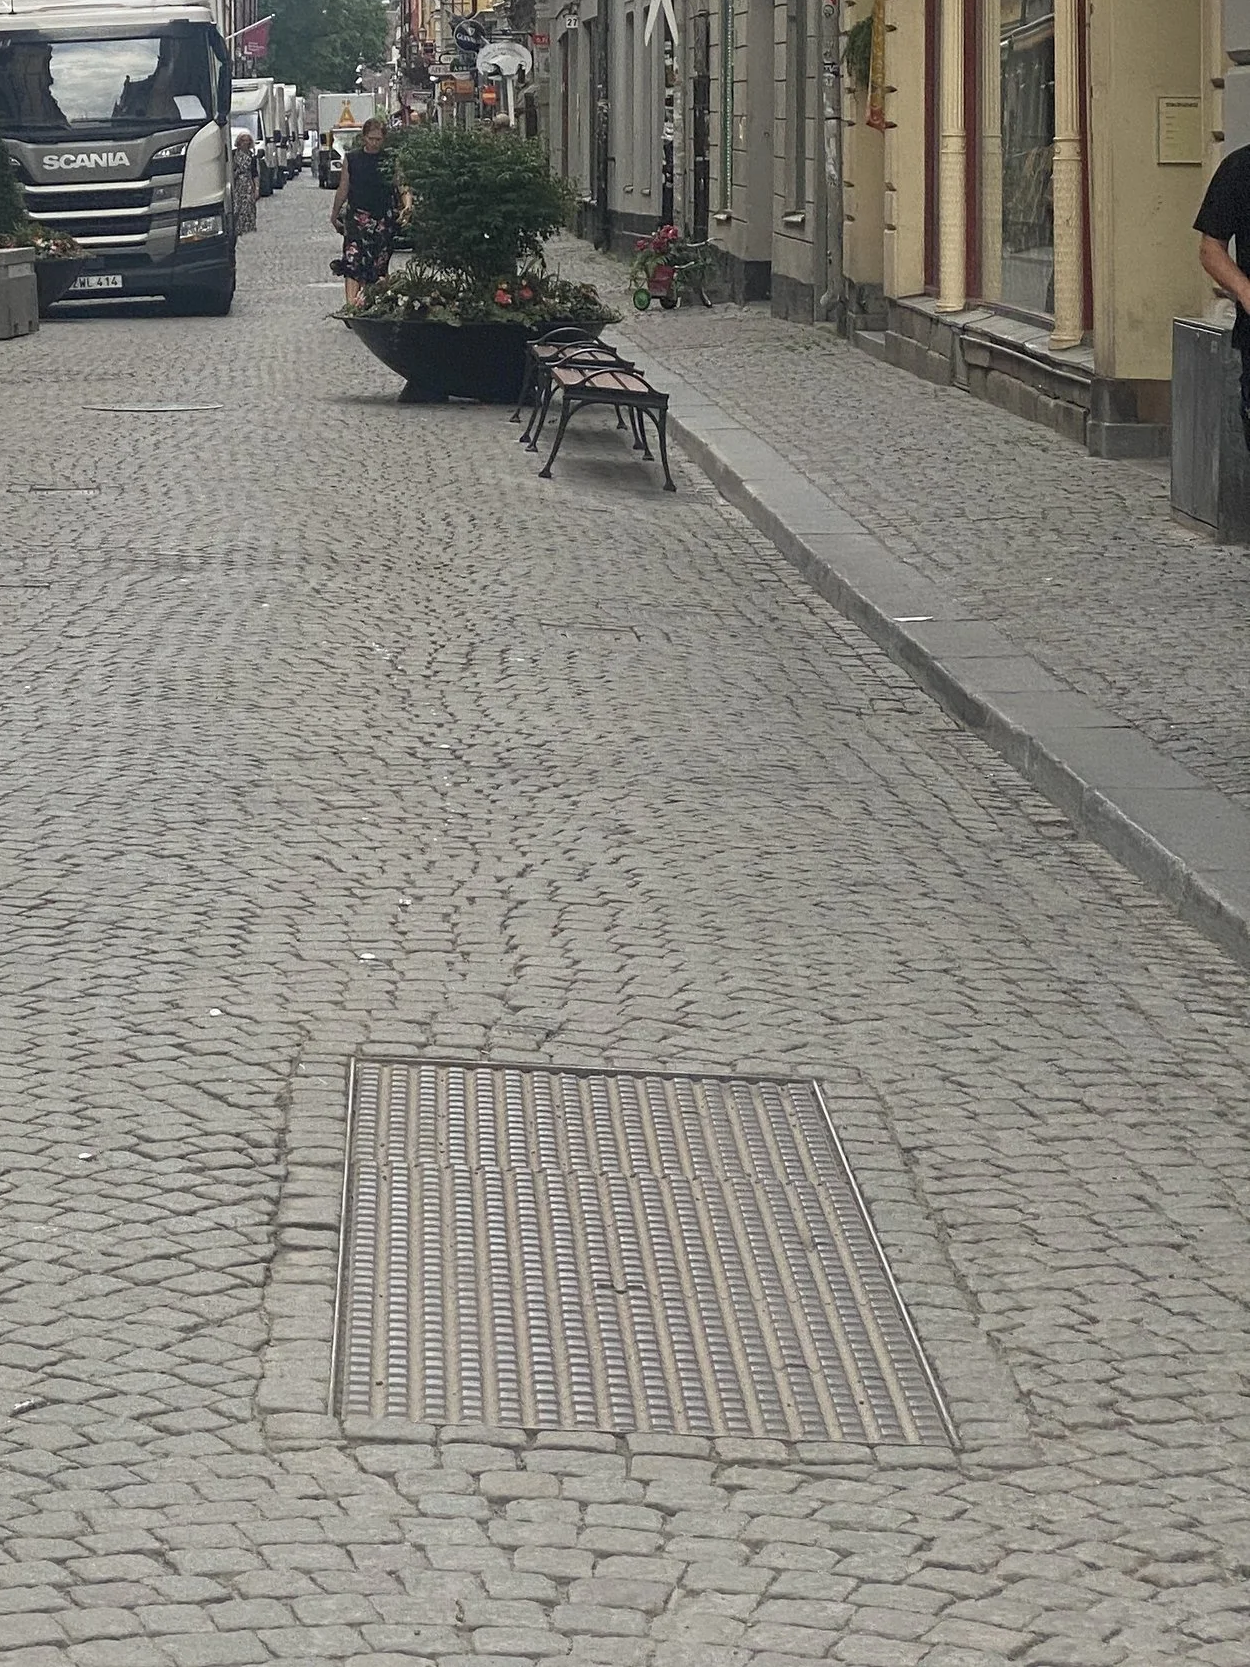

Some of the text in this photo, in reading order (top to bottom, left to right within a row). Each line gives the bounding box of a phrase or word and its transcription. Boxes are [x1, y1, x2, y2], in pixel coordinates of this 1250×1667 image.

[567, 18, 578, 27] 27
[42, 151, 131, 171] SCANIA
[97, 276, 118, 287] 414
